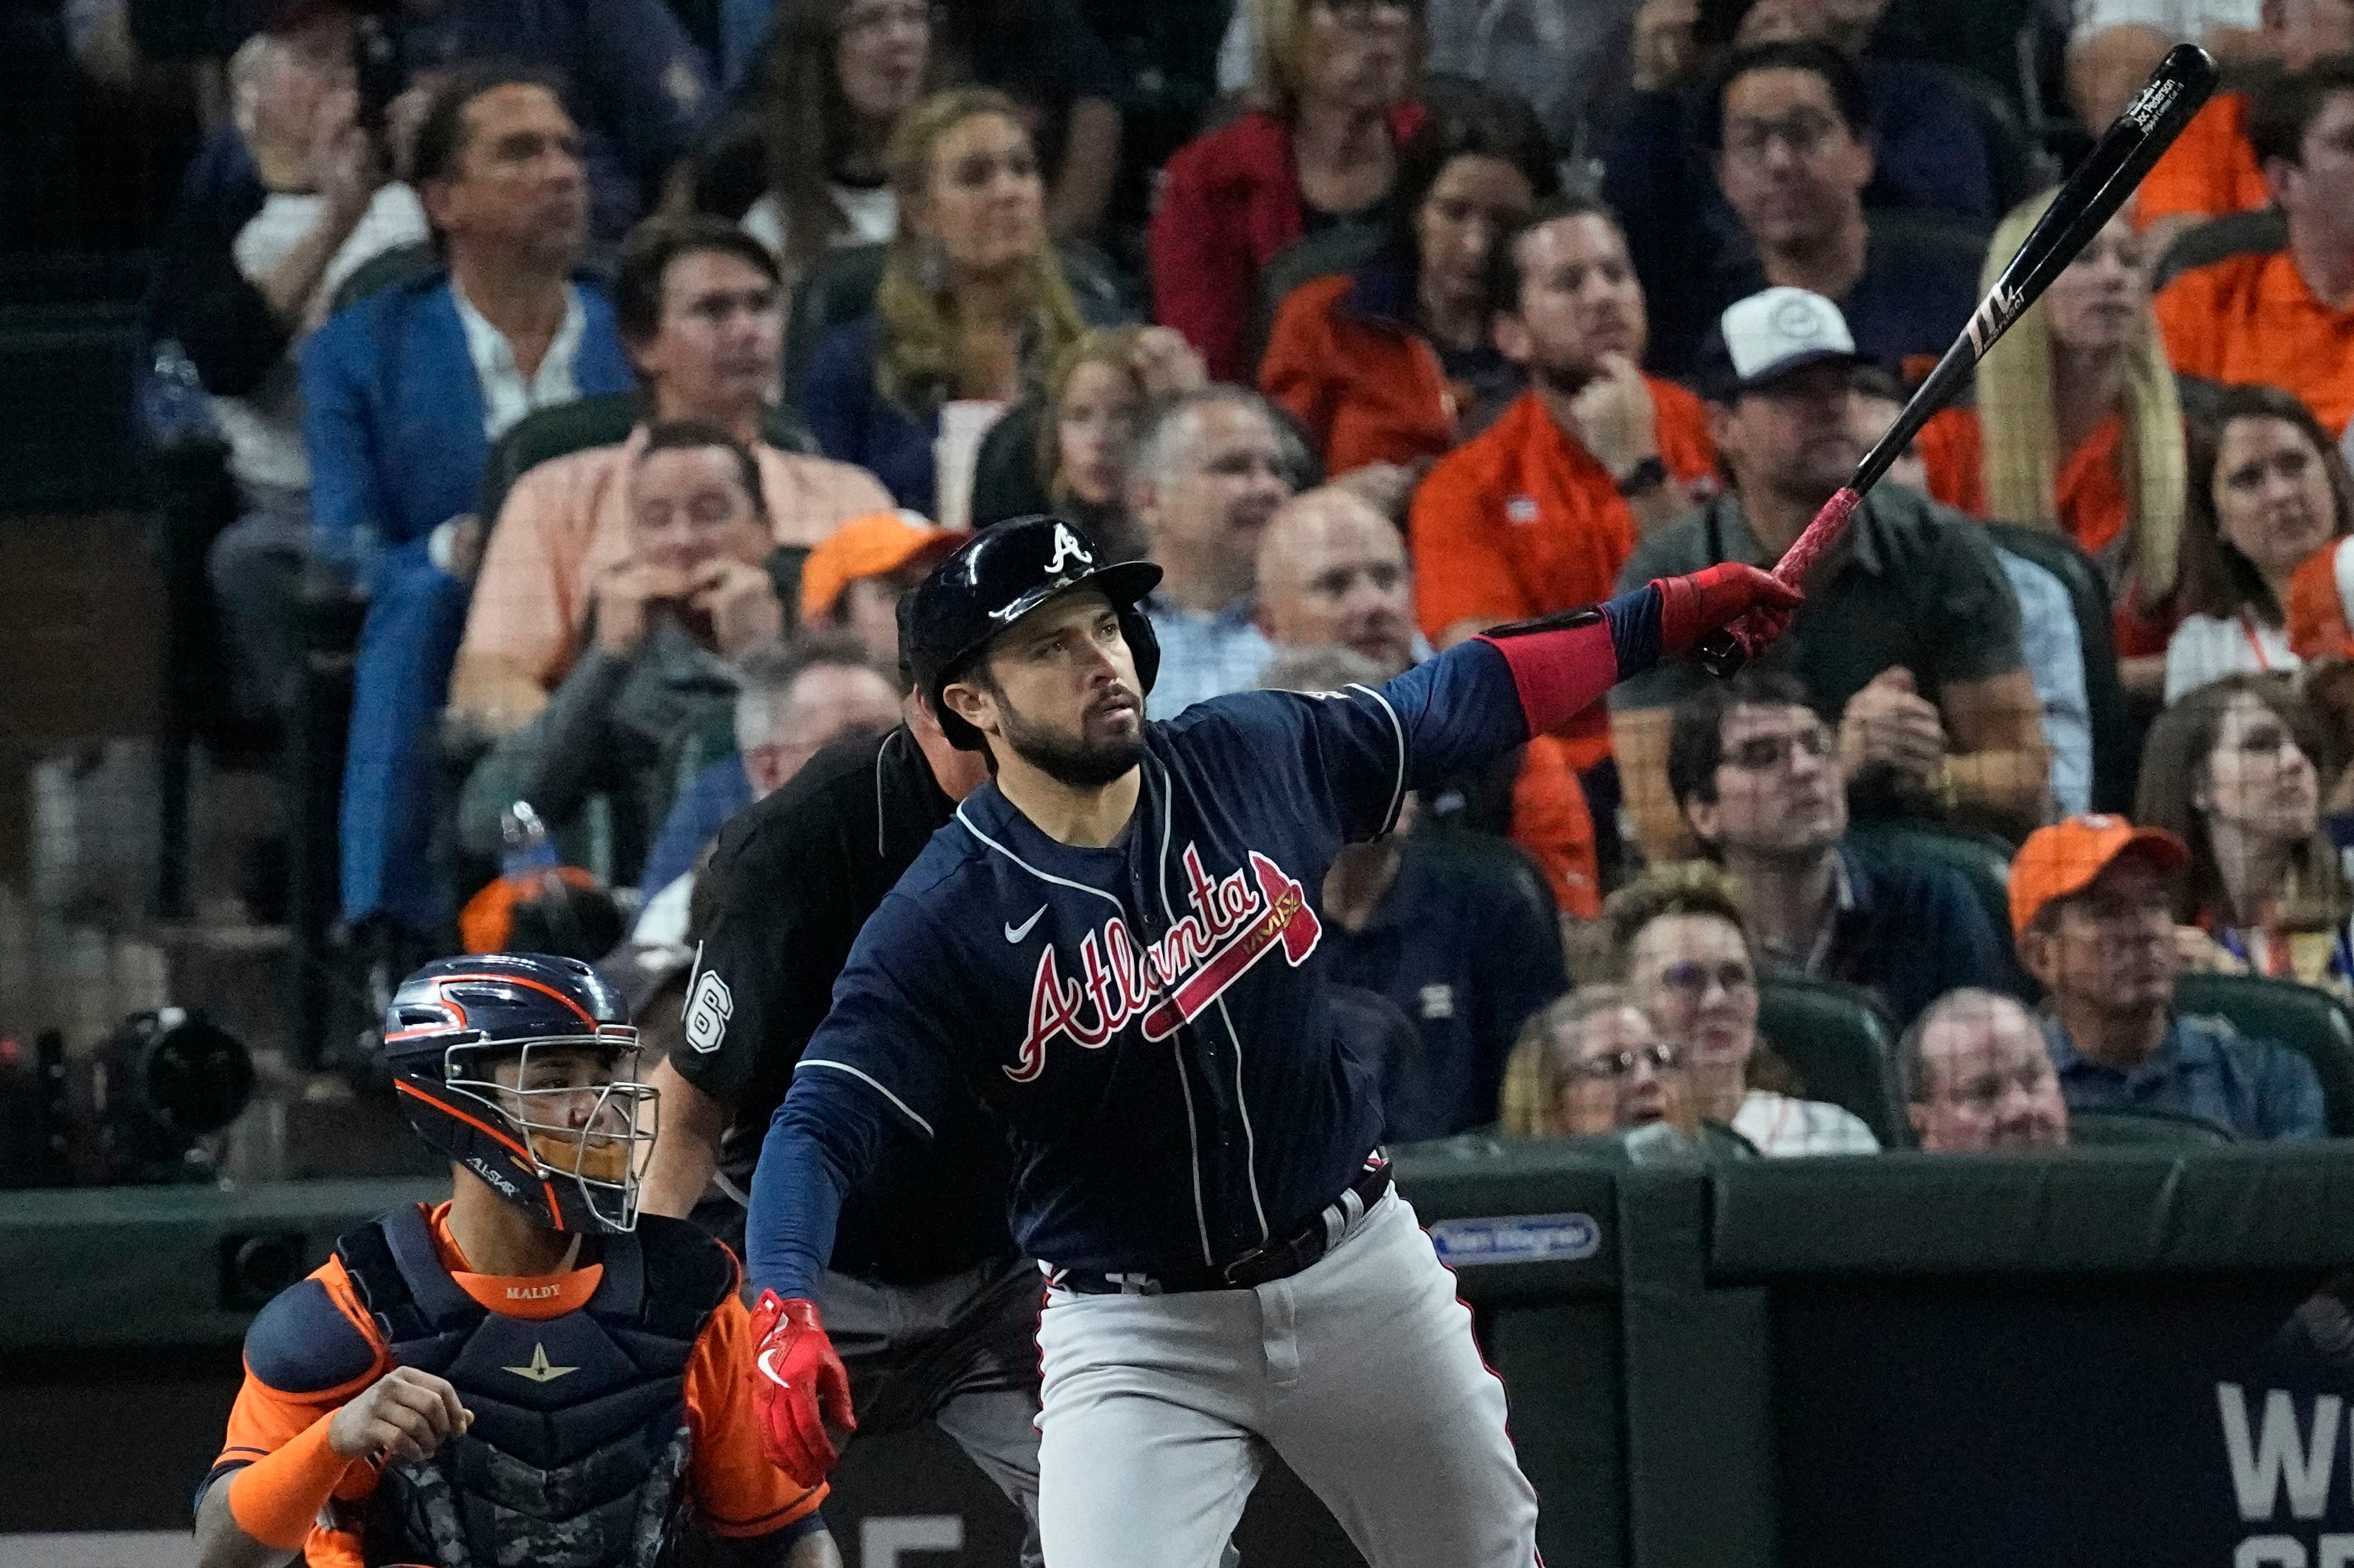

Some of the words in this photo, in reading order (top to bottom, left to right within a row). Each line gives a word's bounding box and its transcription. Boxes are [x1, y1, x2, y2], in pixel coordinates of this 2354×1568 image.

[2134, 110, 2150, 126] Joc
[2143, 78, 2176, 113] Pederson
[1044, 522, 1093, 574] A
[1002, 840, 1260, 1082] Atlanta
[507, 1284, 560, 1299] MALDY
[2216, 1380, 2354, 1521] W
